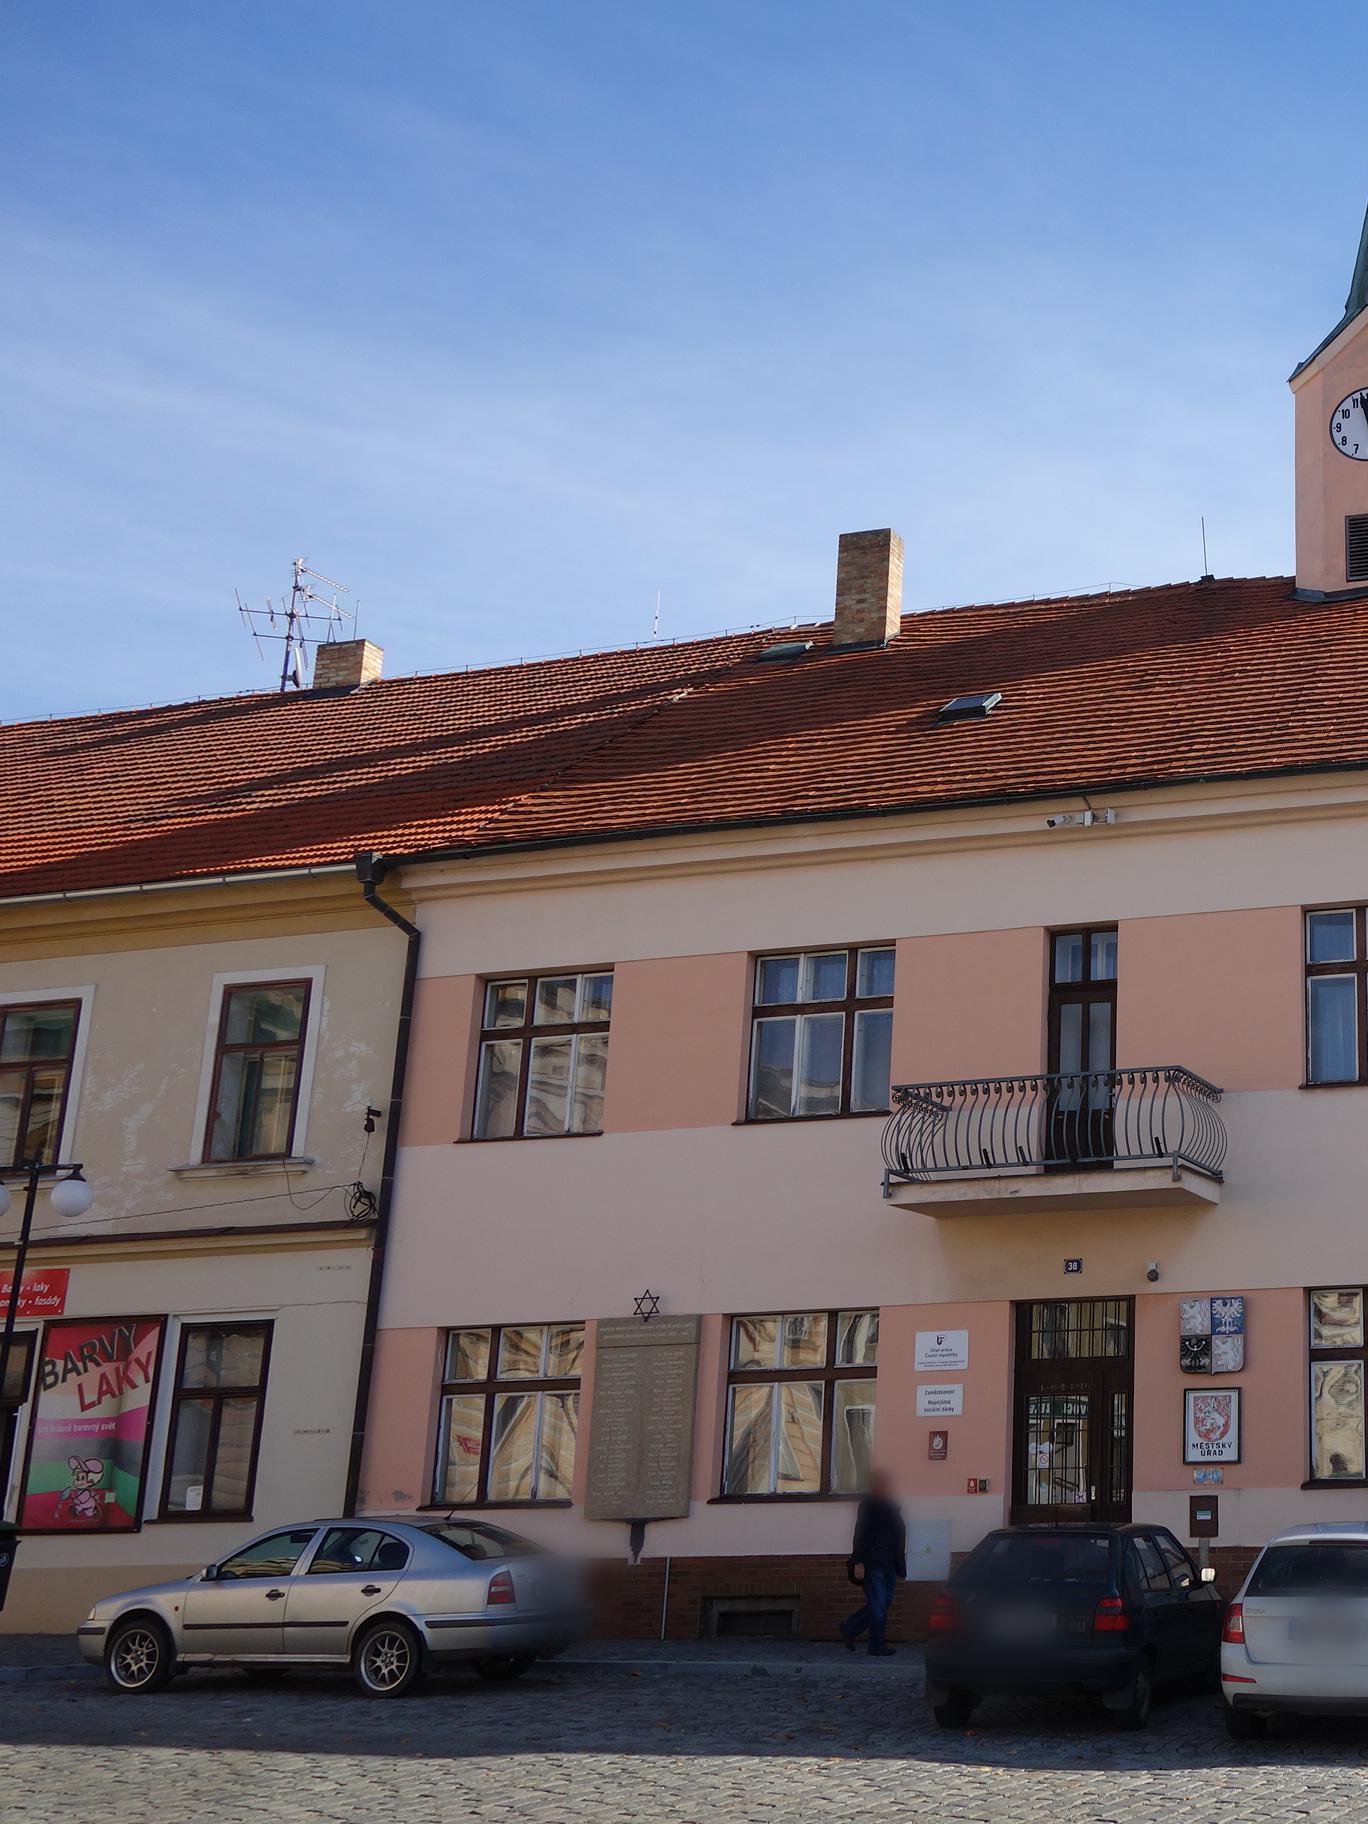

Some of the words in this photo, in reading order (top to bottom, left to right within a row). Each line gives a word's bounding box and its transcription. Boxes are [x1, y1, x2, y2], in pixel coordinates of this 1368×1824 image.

[1352, 398, 1359, 408] 11
[1341, 409, 1350, 419] 10
[1335, 423, 1341, 432] 9
[1341, 436, 1347, 446] 8
[1353, 444, 1359, 454] 7
[1067, 1262, 1078, 1271] 38
[1, 1284, 24, 1293] Bay
[32, 1282, 50, 1293] laky
[40, 1324, 137, 1392] BARVY
[76, 1350, 154, 1412] LAKY
